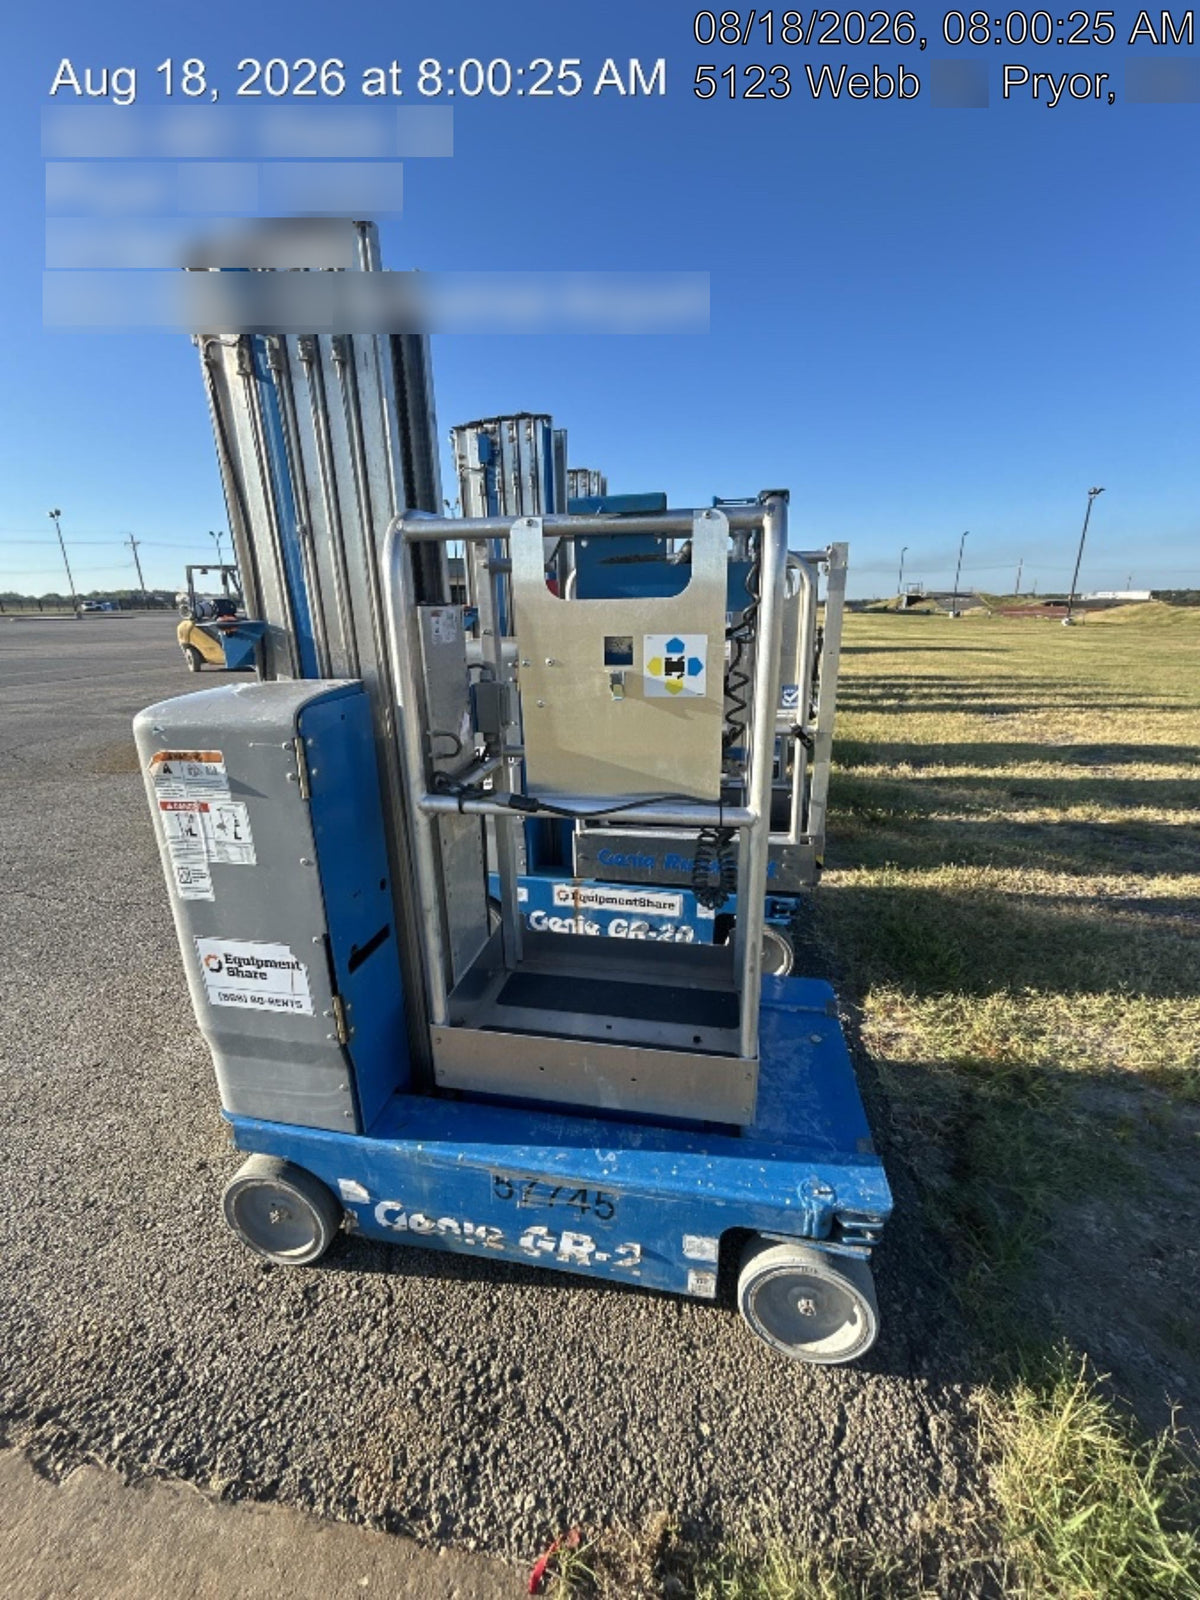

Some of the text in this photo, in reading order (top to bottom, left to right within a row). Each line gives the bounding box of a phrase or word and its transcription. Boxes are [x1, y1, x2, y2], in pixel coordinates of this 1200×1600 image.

[572, 891, 676, 911] EquipmentShare
[528, 909, 600, 936] Genie
[223, 952, 303, 971] Equipment
[226, 966, 268, 981] Share
[374, 1199, 506, 1250] Genie
